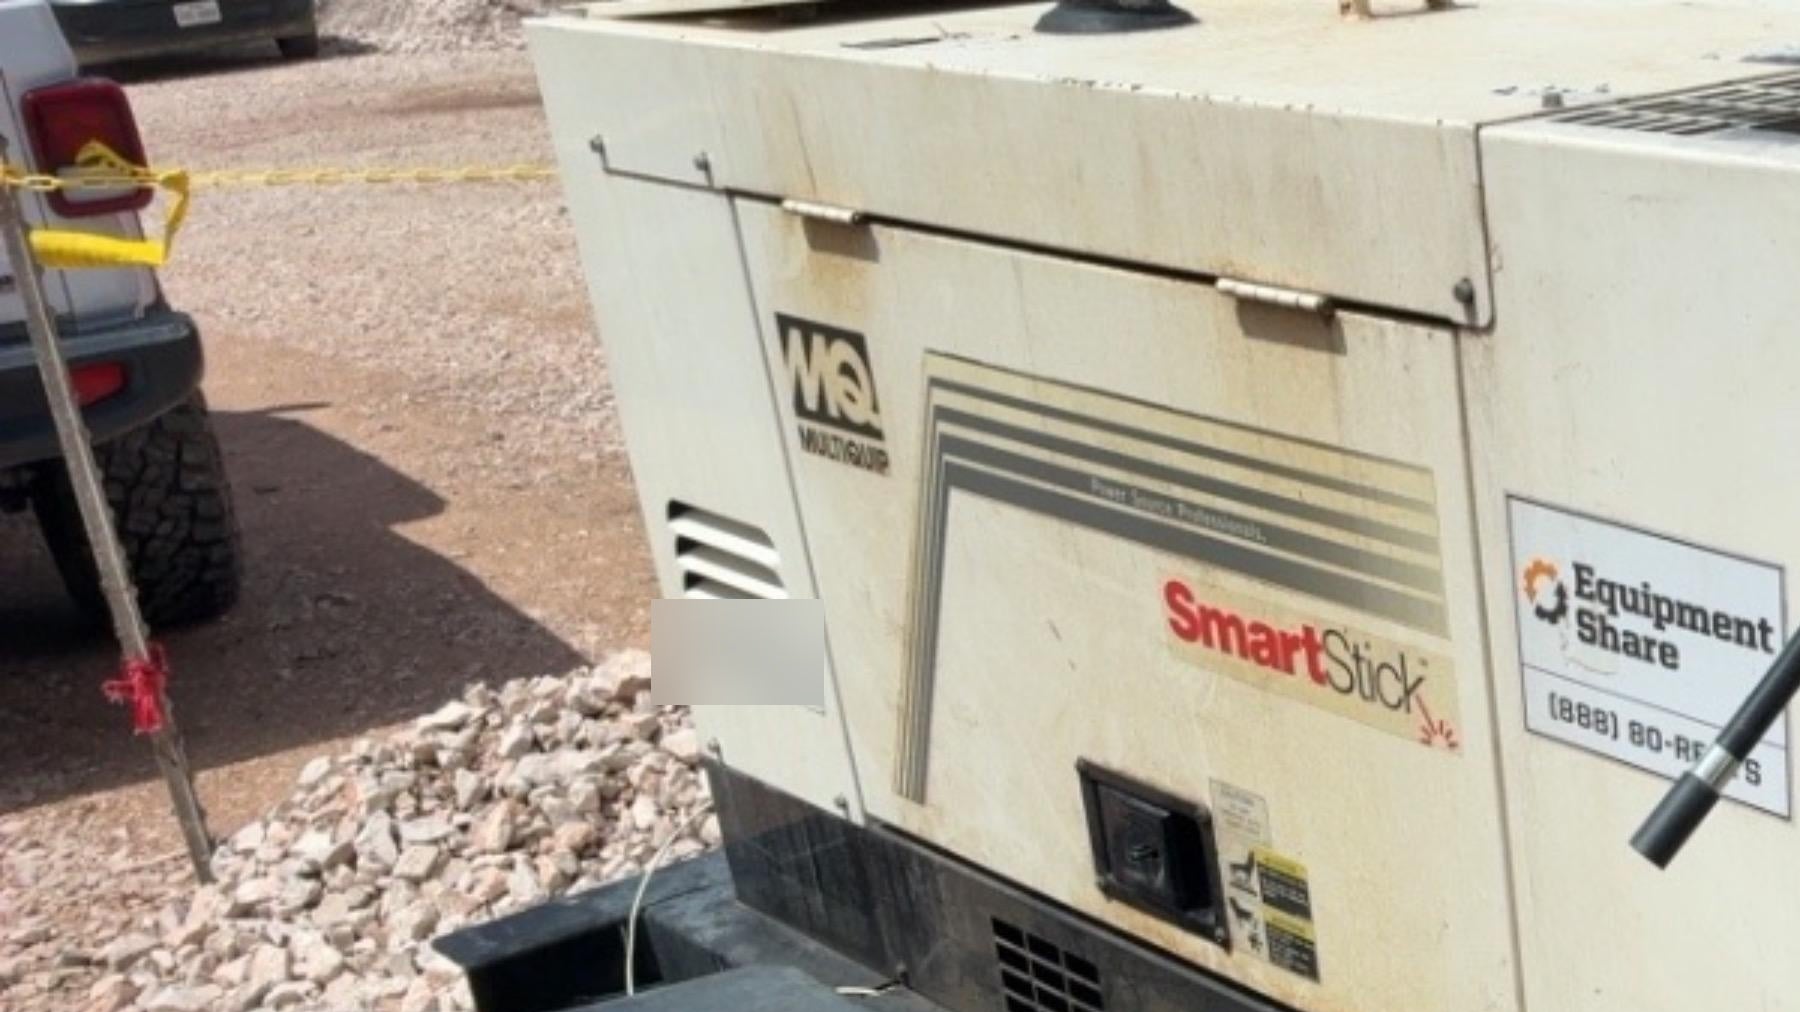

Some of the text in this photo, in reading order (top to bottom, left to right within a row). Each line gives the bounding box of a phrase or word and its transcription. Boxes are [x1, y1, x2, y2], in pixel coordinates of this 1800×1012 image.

[1572, 562, 1775, 654] Equipment
[1575, 608, 1680, 670] Share
[1548, 692, 1762, 786] (888) 80-RES
